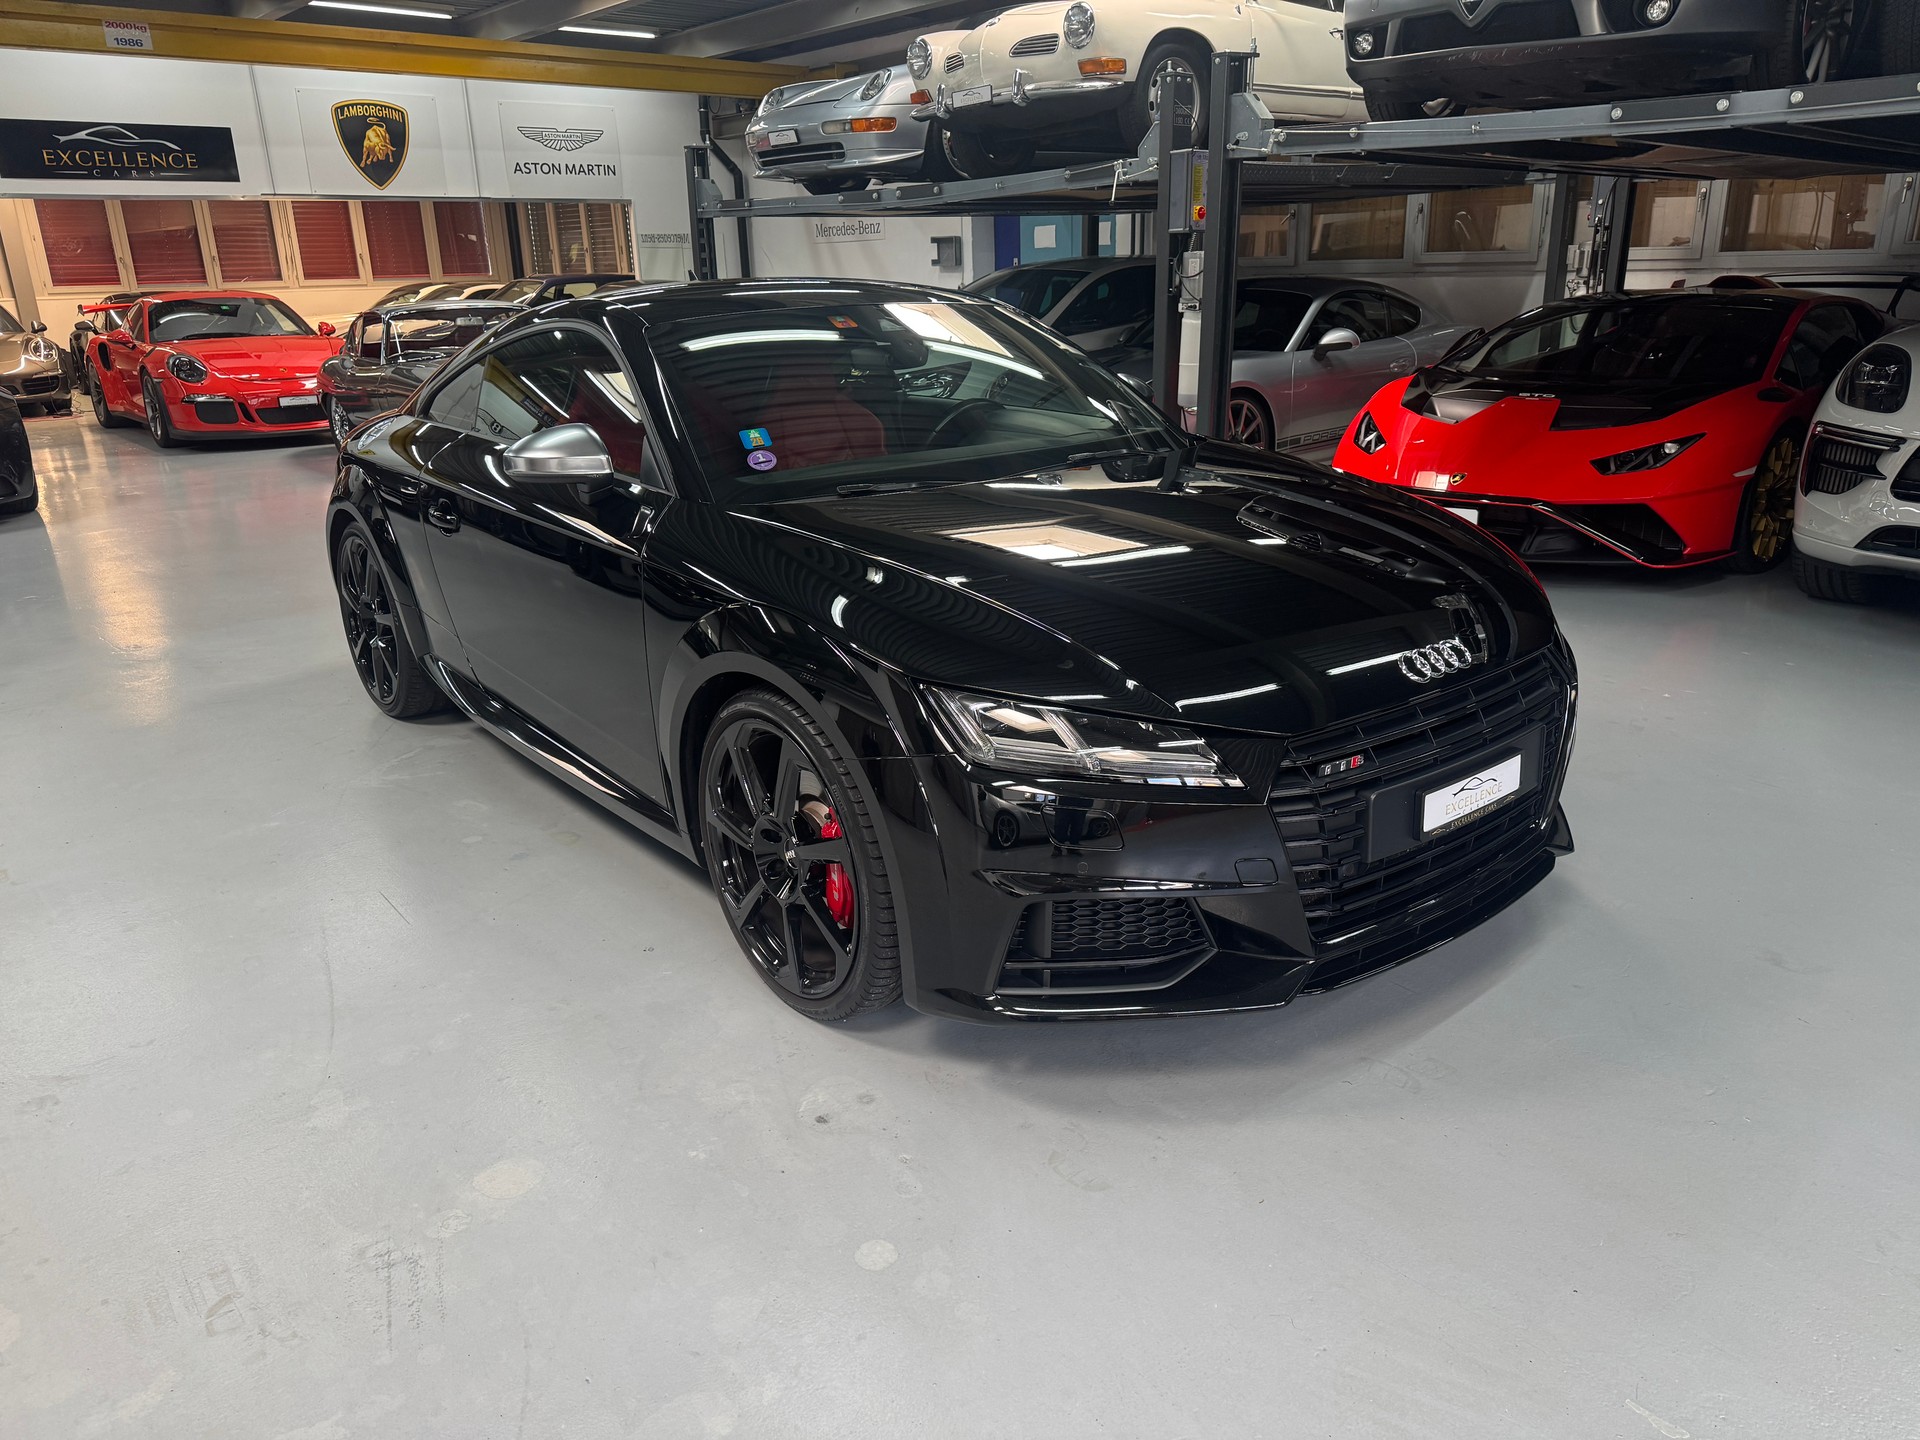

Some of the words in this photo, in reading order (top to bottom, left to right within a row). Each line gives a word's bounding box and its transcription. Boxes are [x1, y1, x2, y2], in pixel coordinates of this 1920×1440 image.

[104, 20, 148, 33] 2000kg
[113, 37, 144, 48] 1986
[337, 105, 403, 123] LAMBORGHINI
[42, 149, 199, 169] EXCELLENCE
[93, 169, 155, 178] CARS
[513, 162, 562, 175] ASTON
[565, 163, 617, 176] MARTIN
[815, 220, 882, 238] Mercedes-Benz
[756, 453, 767, 462] 1
[1445, 781, 1503, 816] EXCELLENCE
